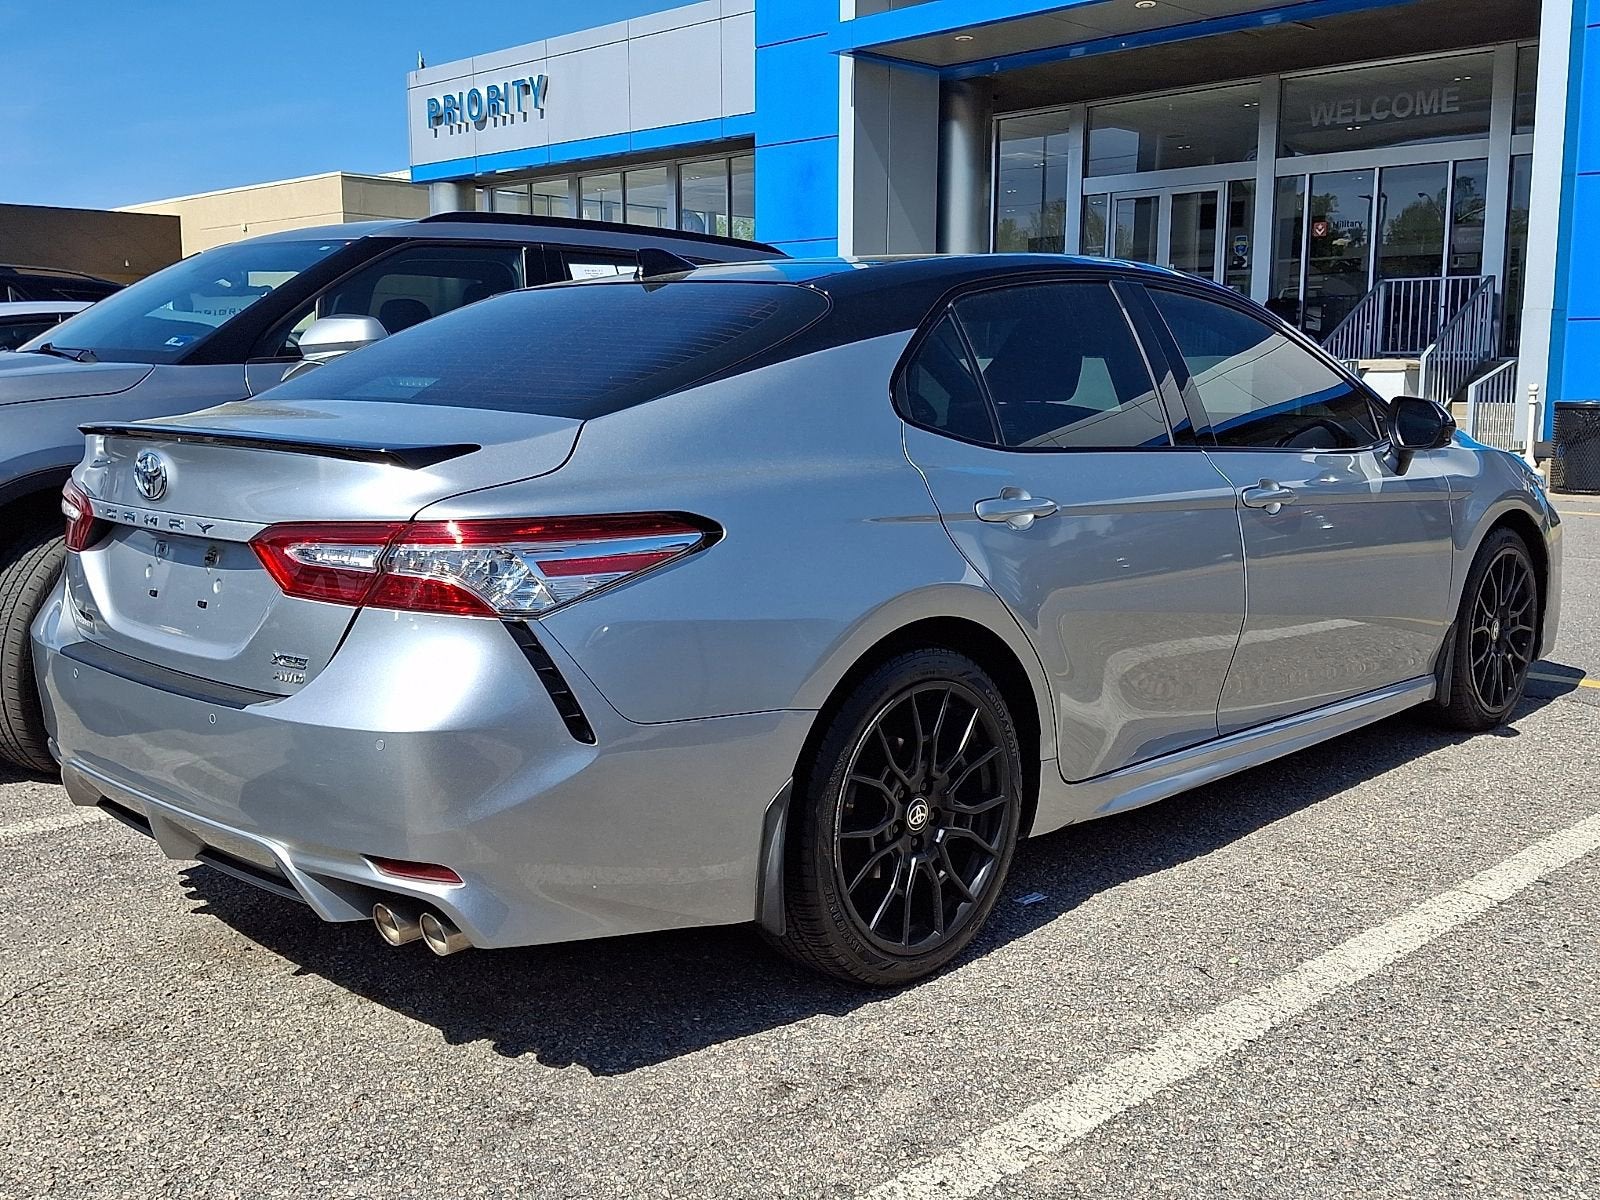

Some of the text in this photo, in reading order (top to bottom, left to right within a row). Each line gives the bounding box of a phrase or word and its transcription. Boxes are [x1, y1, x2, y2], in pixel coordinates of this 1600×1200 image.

[427, 74, 547, 130] PRIORITY
[1309, 86, 1460, 127] WELCOME
[105, 507, 216, 535] CAMRY
